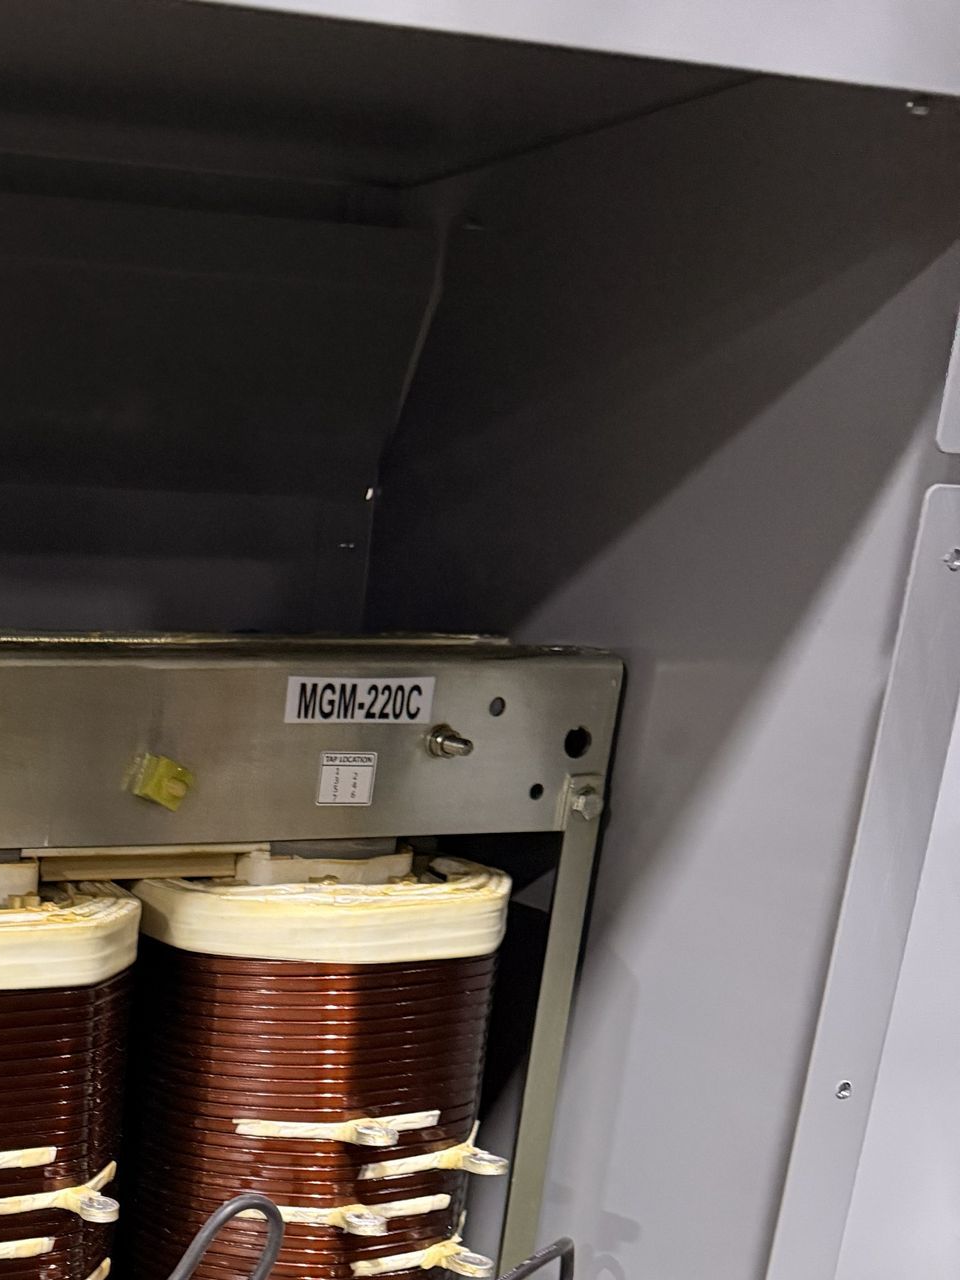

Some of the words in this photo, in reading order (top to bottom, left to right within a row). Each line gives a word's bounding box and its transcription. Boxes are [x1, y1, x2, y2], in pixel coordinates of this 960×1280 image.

[296, 682, 423, 720] MGM-220C
[325, 755, 338, 764] TAP
[339, 755, 373, 764] LOCATION
